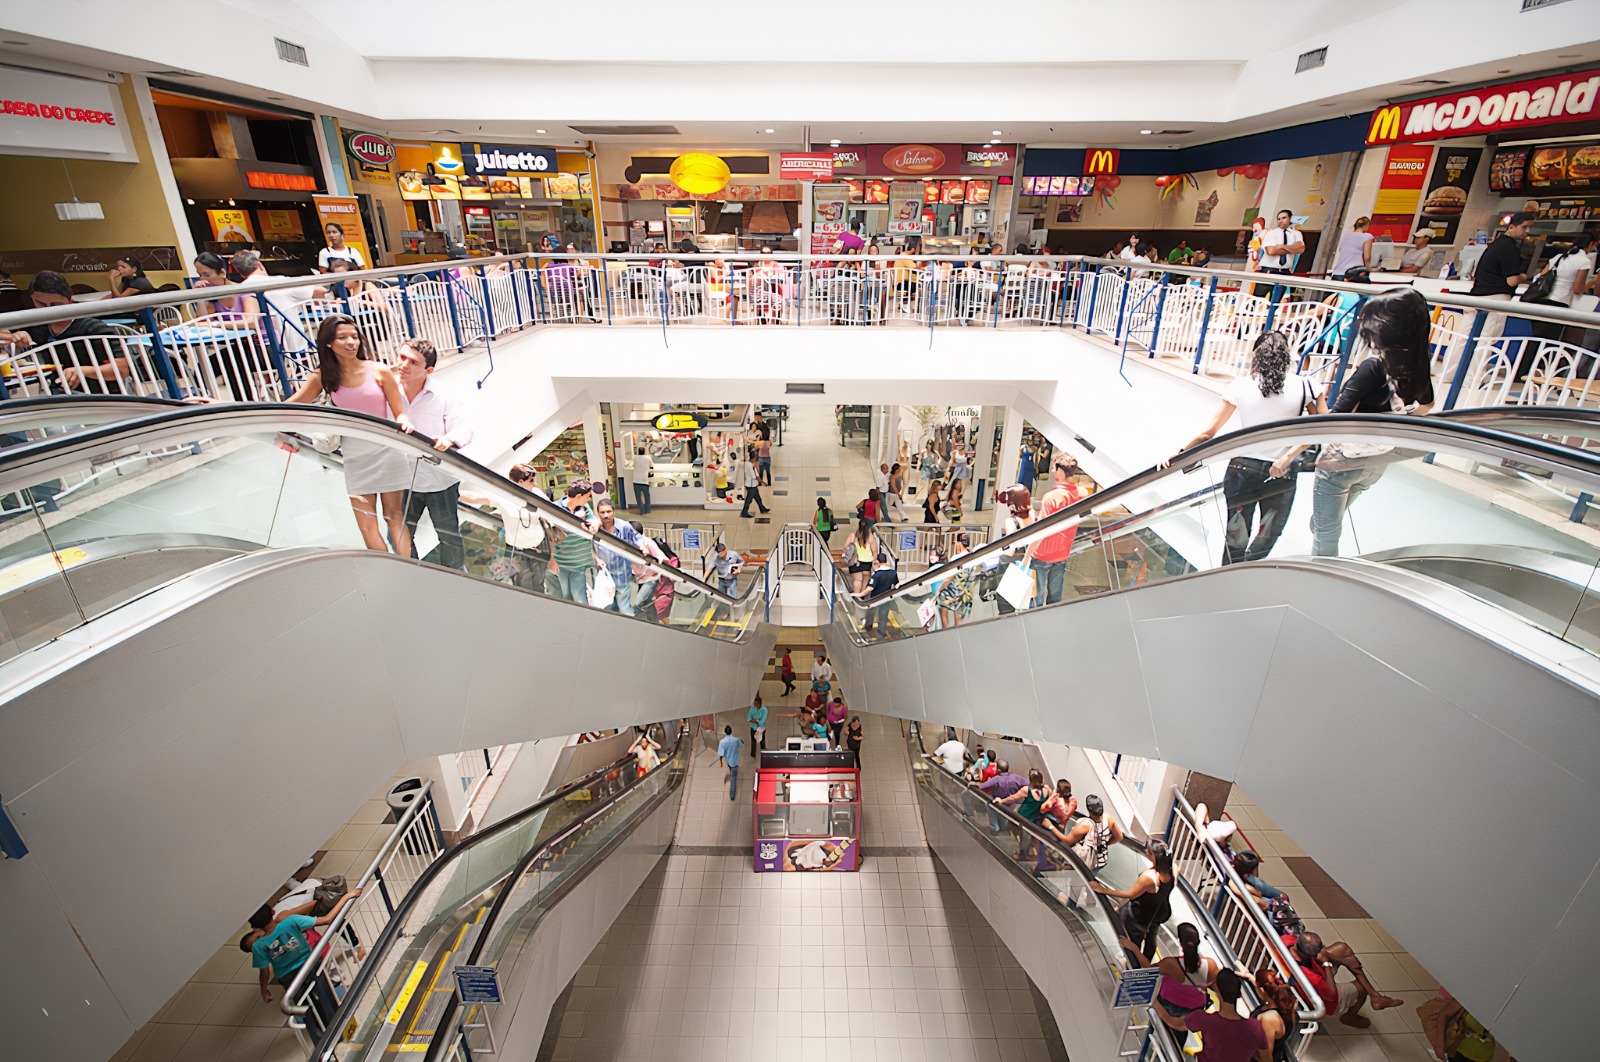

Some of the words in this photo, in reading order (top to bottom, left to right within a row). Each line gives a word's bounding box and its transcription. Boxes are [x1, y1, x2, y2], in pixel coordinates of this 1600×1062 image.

[40, 104, 64, 120] DO
[65, 107, 116, 126] CREPE
[360, 140, 394, 157] JUBA
